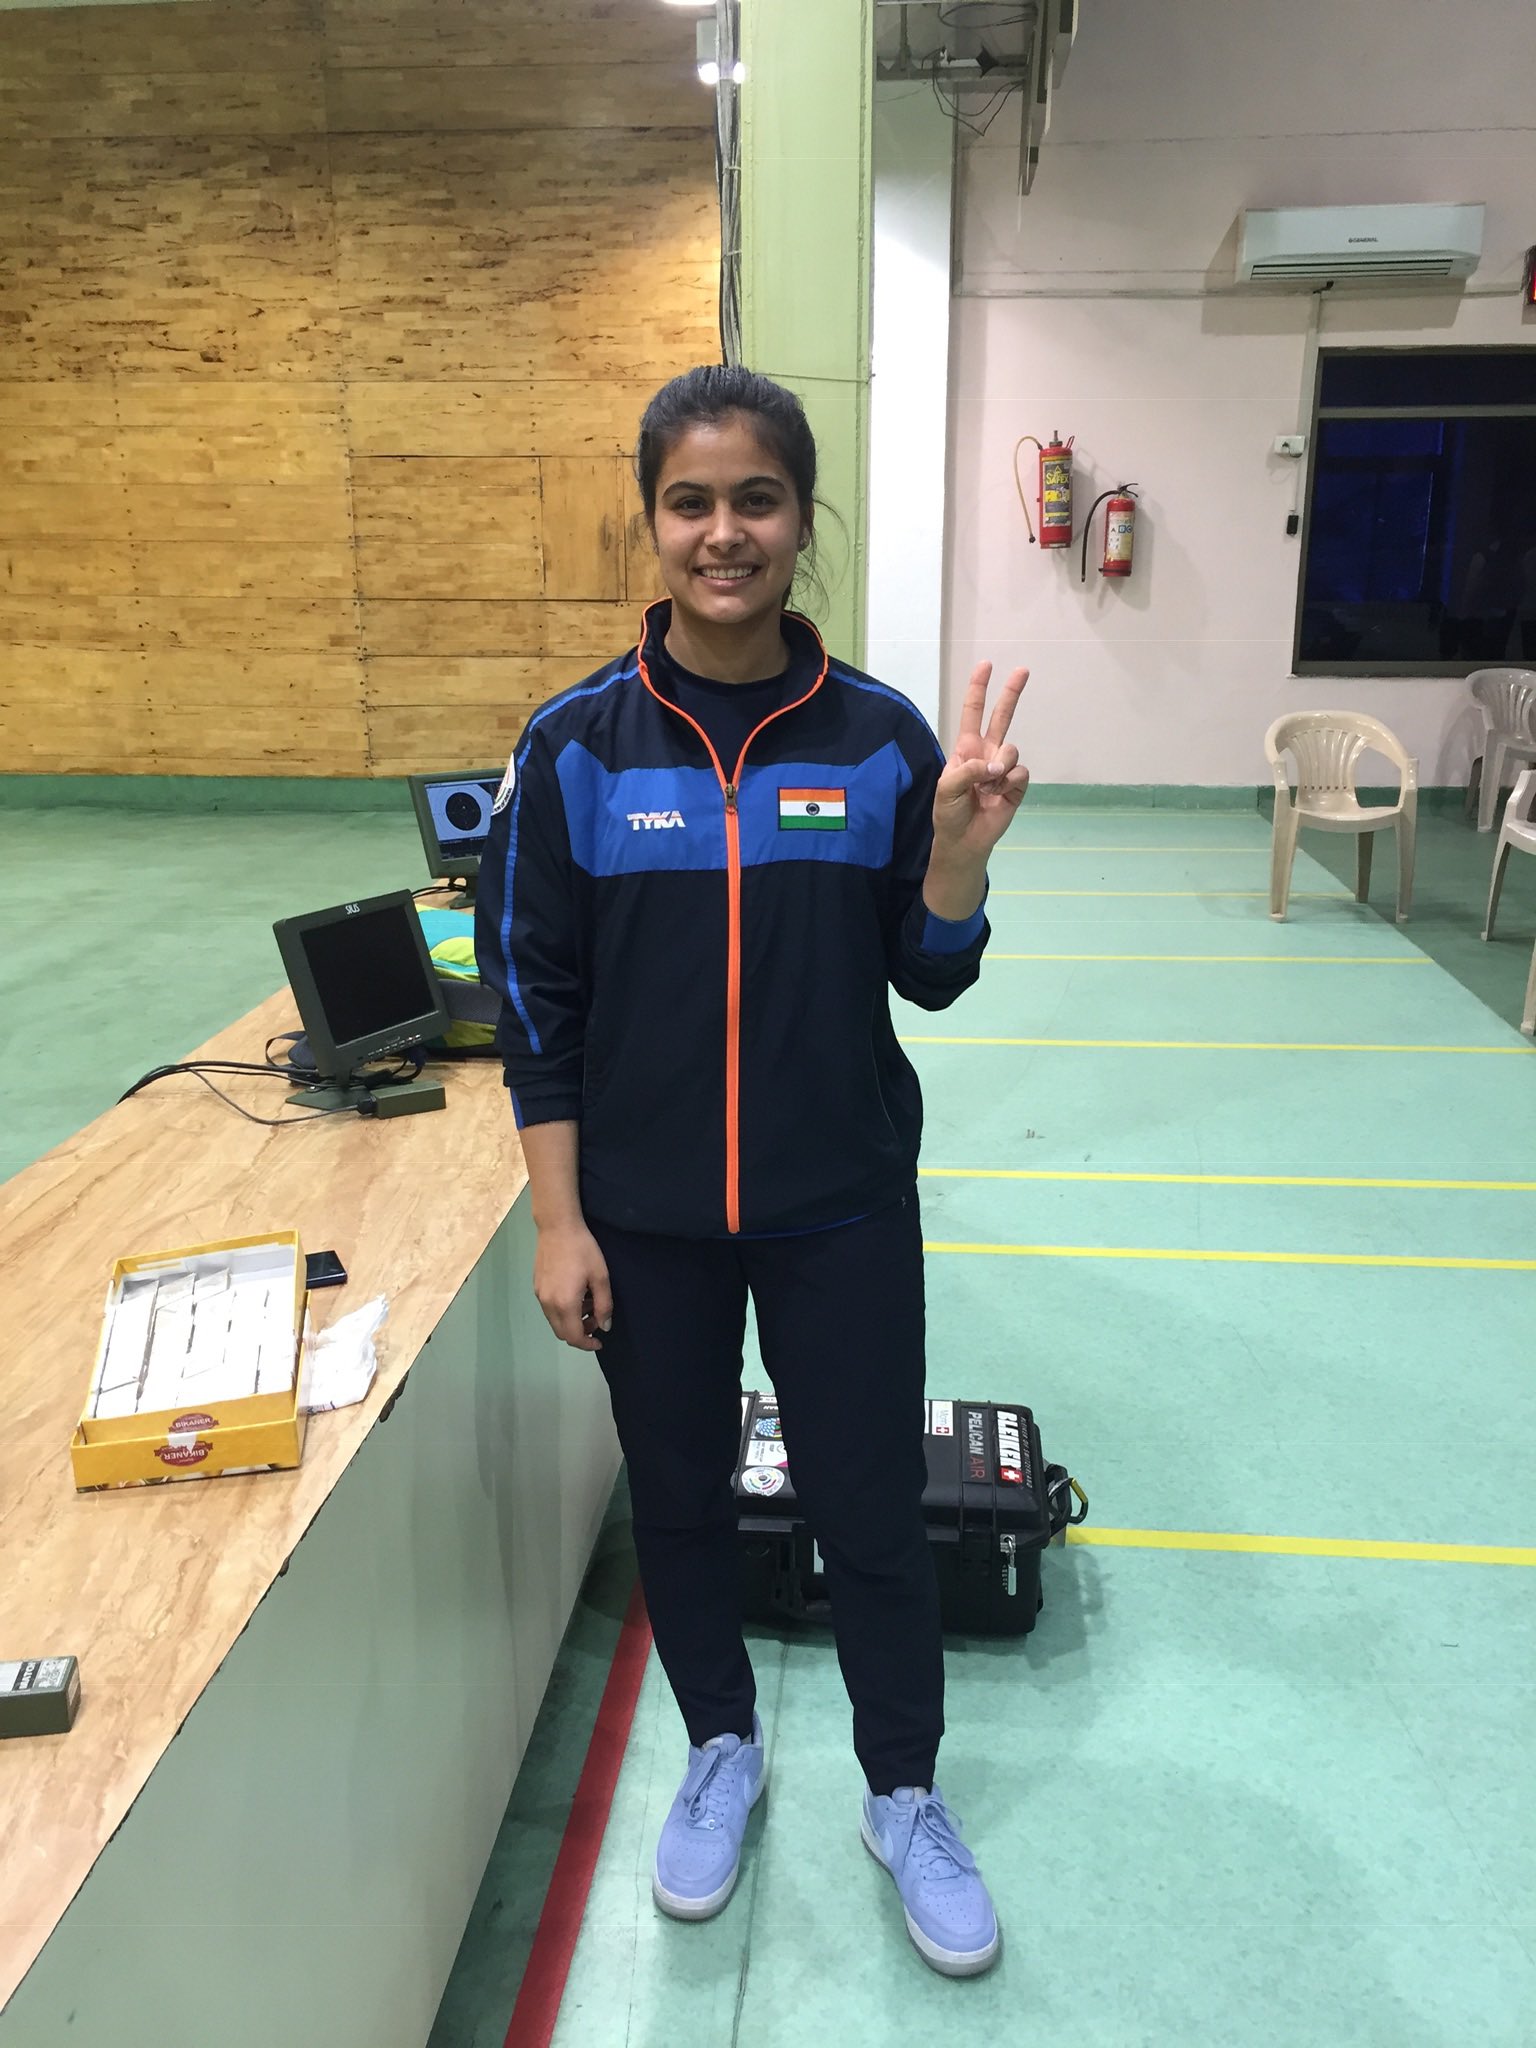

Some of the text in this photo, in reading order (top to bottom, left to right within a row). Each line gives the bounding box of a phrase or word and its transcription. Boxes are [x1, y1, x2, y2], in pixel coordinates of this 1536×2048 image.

[627, 811, 686, 831] TYKA
[345, 903, 360, 915] SIUS
[175, 1417, 211, 1428] BIKANER
[968, 1411, 985, 1479] PELICAN AIR
[997, 1411, 1021, 1468] BLEIKER
[163, 1449, 205, 1460] BIKANER
